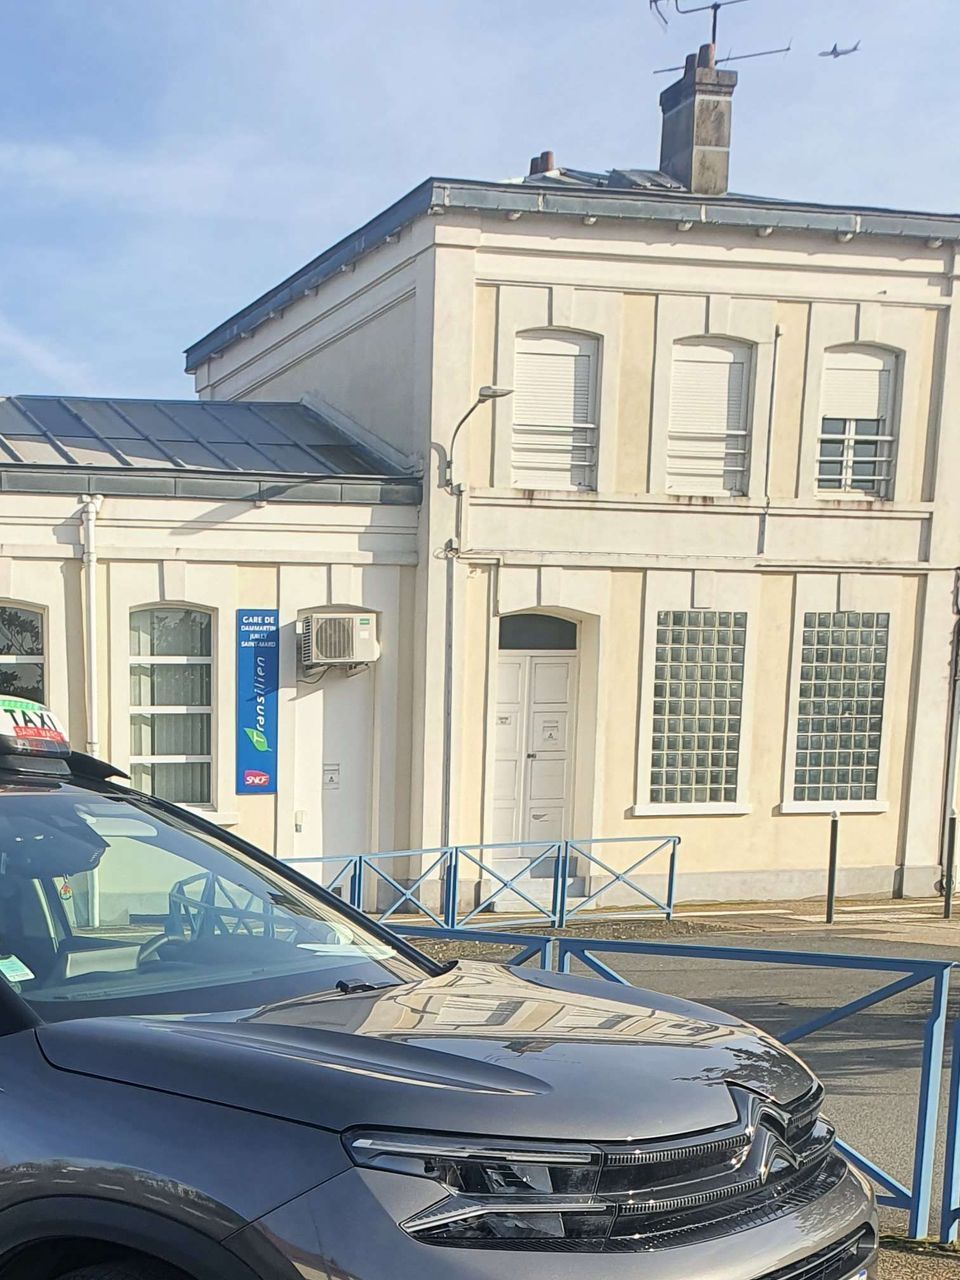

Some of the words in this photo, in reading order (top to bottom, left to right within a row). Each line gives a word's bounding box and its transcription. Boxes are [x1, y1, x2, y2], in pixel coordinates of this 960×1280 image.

[242, 616, 263, 624] GARE
[264, 616, 275, 624] DE
[253, 656, 266, 743] Transilien
[3, 709, 58, 732] TAXI
[16, 727, 37, 736] SAINT
[245, 775, 268, 785] SNCF
